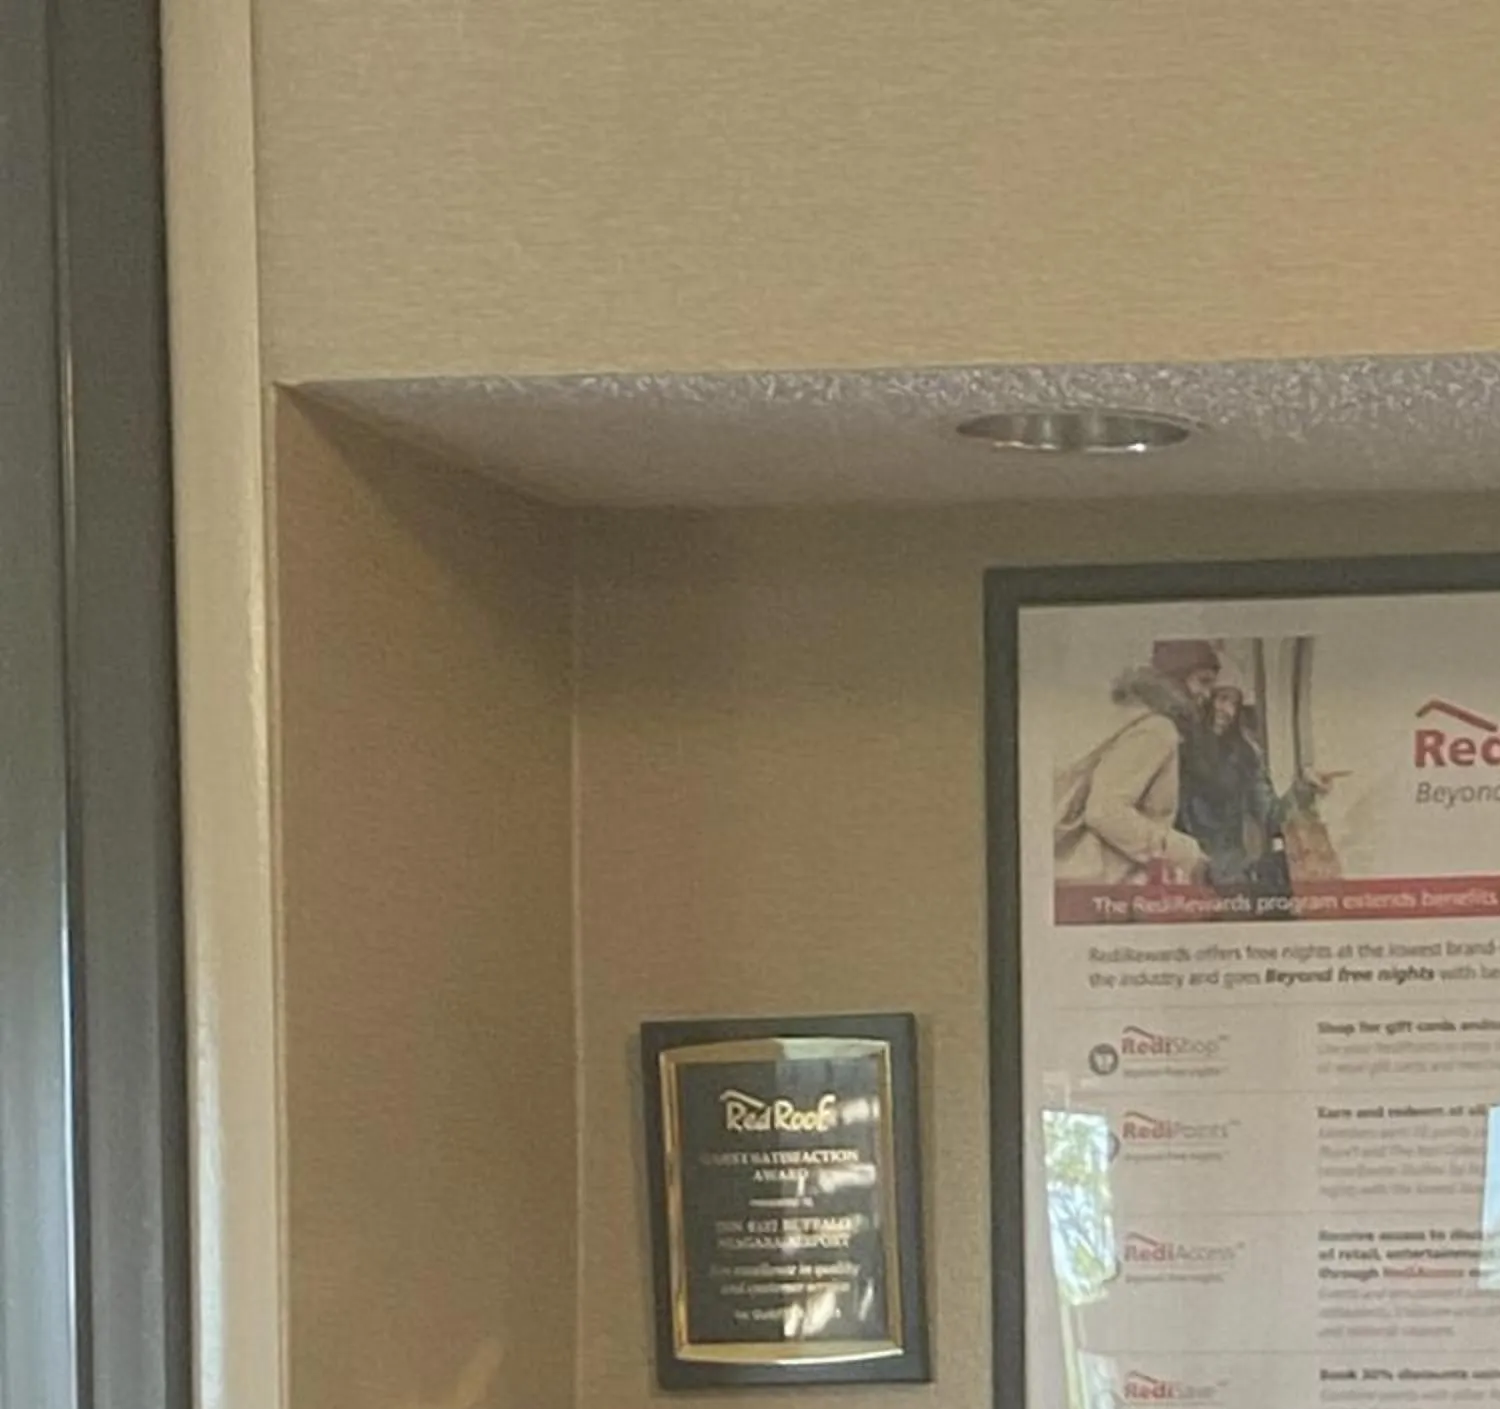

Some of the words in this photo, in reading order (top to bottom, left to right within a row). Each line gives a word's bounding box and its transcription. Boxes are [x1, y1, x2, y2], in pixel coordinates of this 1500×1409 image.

[1092, 896, 1126, 913] The
[1257, 893, 1338, 914] program
[1421, 888, 1499, 907] benefits
[1246, 944, 1277, 960] free
[1282, 943, 1333, 963] nights
[1338, 944, 1353, 958] at
[1357, 943, 1383, 958] the
[1089, 972, 1116, 988] the
[1189, 971, 1219, 986] and
[1265, 967, 1332, 986] Beyond
[1338, 966, 1373, 982] free
[1377, 964, 1435, 984] nights
[1440, 964, 1476, 979] with
[1385, 1019, 1413, 1036] gift
[725, 1098, 771, 1132] Red
[774, 1094, 836, 1131] Roof
